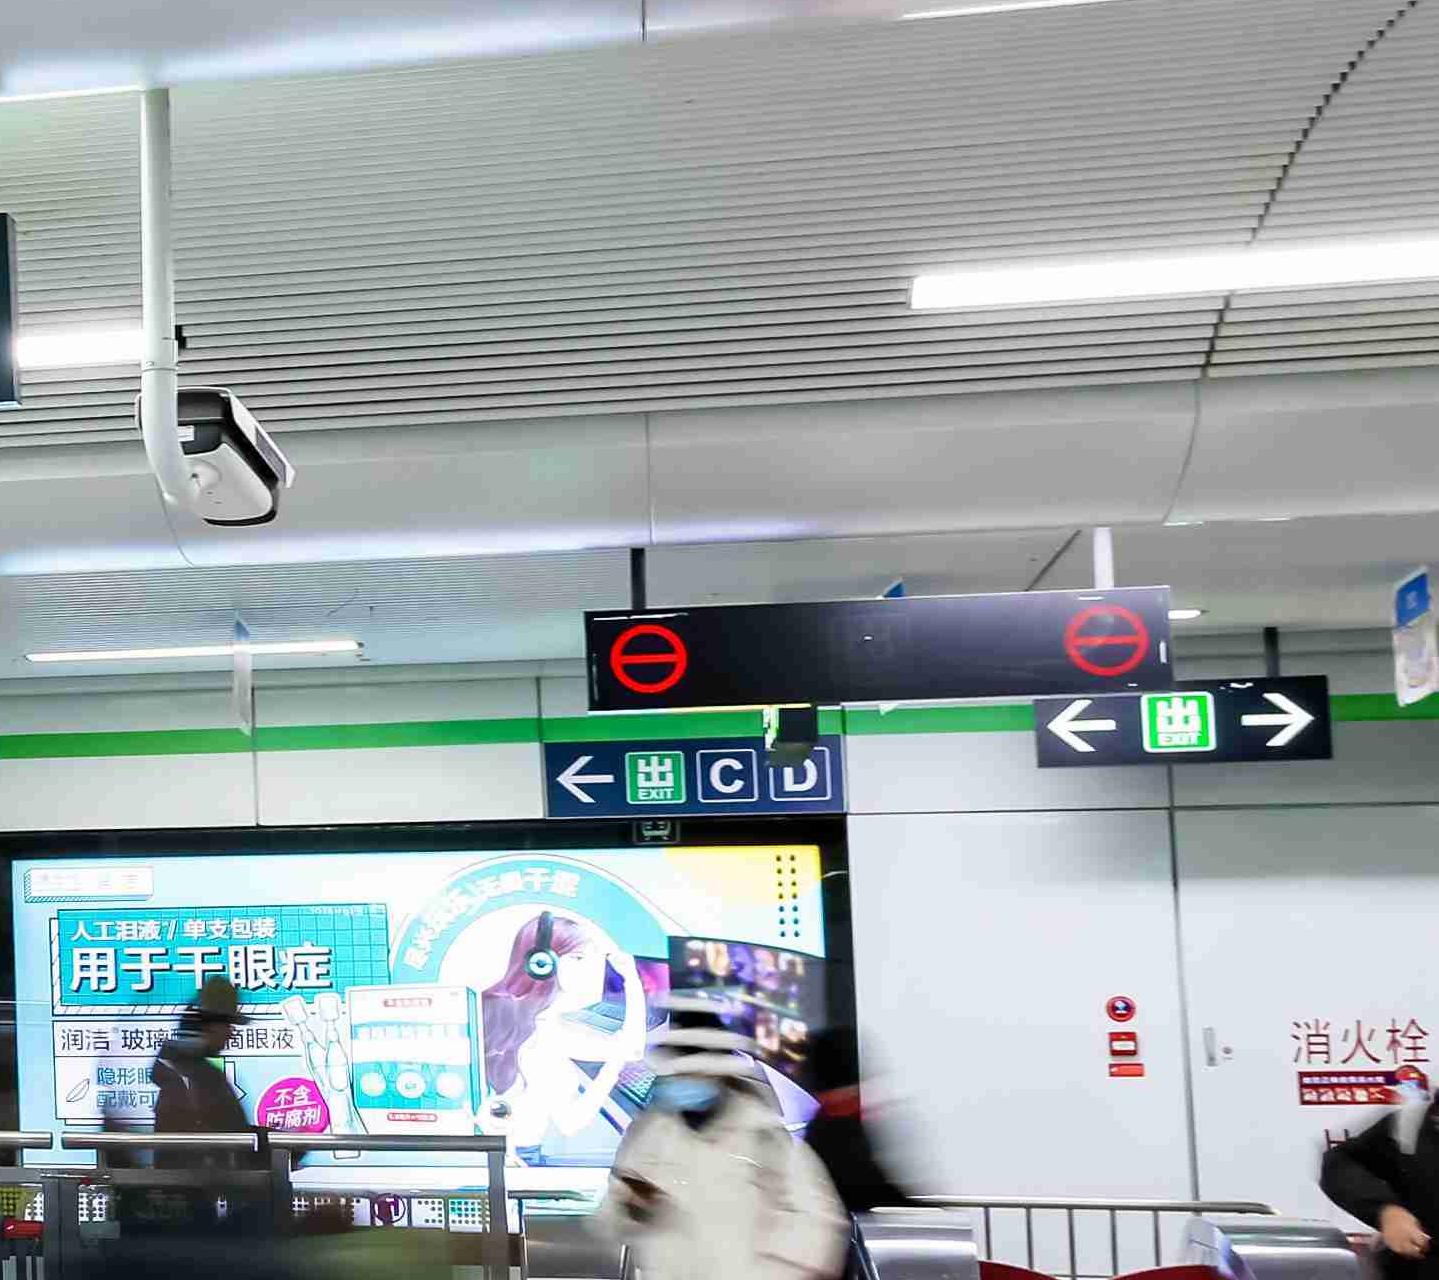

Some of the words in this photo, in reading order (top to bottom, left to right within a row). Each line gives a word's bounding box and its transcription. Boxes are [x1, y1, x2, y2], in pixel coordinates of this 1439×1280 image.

[637, 755, 674, 788] 出
[638, 788, 674, 800] EXIT
[710, 758, 745, 794] C
[783, 758, 818, 792] D
[71, 919, 162, 942] 人工泪液
[185, 916, 277, 940] 单支包装
[71, 943, 334, 994] 用于干眼症
[122, 1025, 295, 1051] 玻璃滴眼液
[1291, 1018, 1430, 1065] 消火栓
[275, 1088, 309, 1108] 不含
[265, 1109, 322, 1130] 防腐剂
